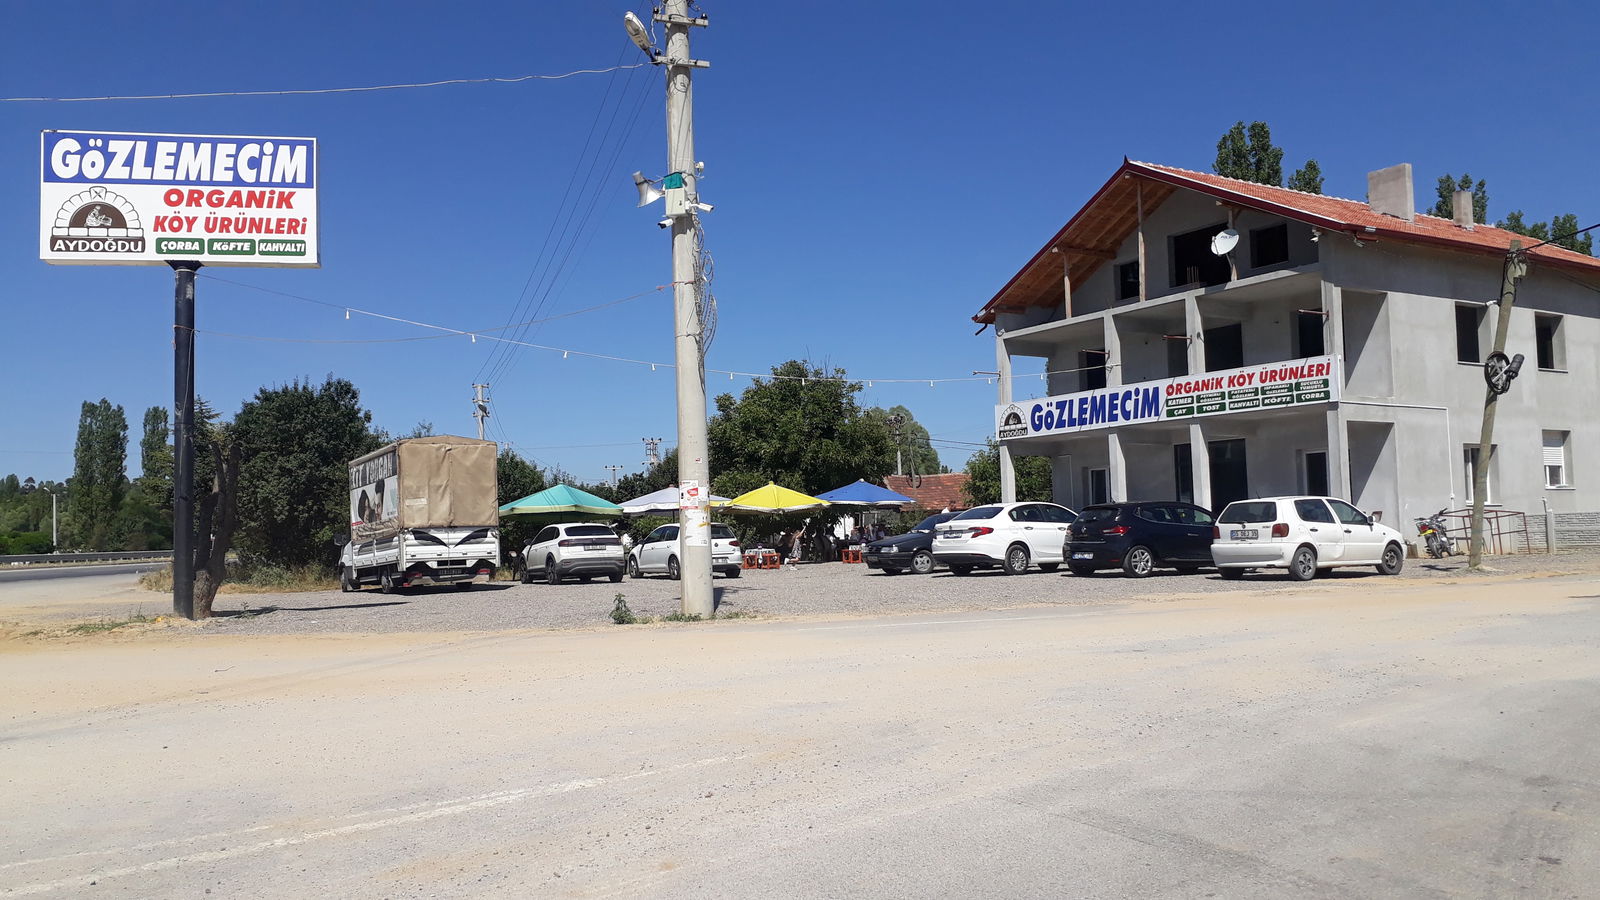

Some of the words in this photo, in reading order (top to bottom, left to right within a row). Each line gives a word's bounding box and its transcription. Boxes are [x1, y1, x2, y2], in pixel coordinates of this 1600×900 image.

[51, 138, 307, 184] GöZLEMECiM
[163, 189, 296, 209] ORGANiK
[153, 211, 198, 233] KÖY
[204, 212, 308, 235] ÜRÜNLERi
[53, 238, 142, 252] AYDOĞDU
[160, 240, 200, 252] ÇORBA
[259, 242, 305, 253] KAHVALTI
[1227, 370, 1256, 388] KÖY
[1259, 358, 1331, 384] ÜRÜNLERİ
[1301, 393, 1325, 401] ÇORBA
[1030, 387, 1160, 432] GöZLEMECiM
[1229, 400, 1259, 409] KAHVALTI
[1174, 408, 1187, 416] ÇAY
[1000, 429, 1028, 438] AYDOĞDU
